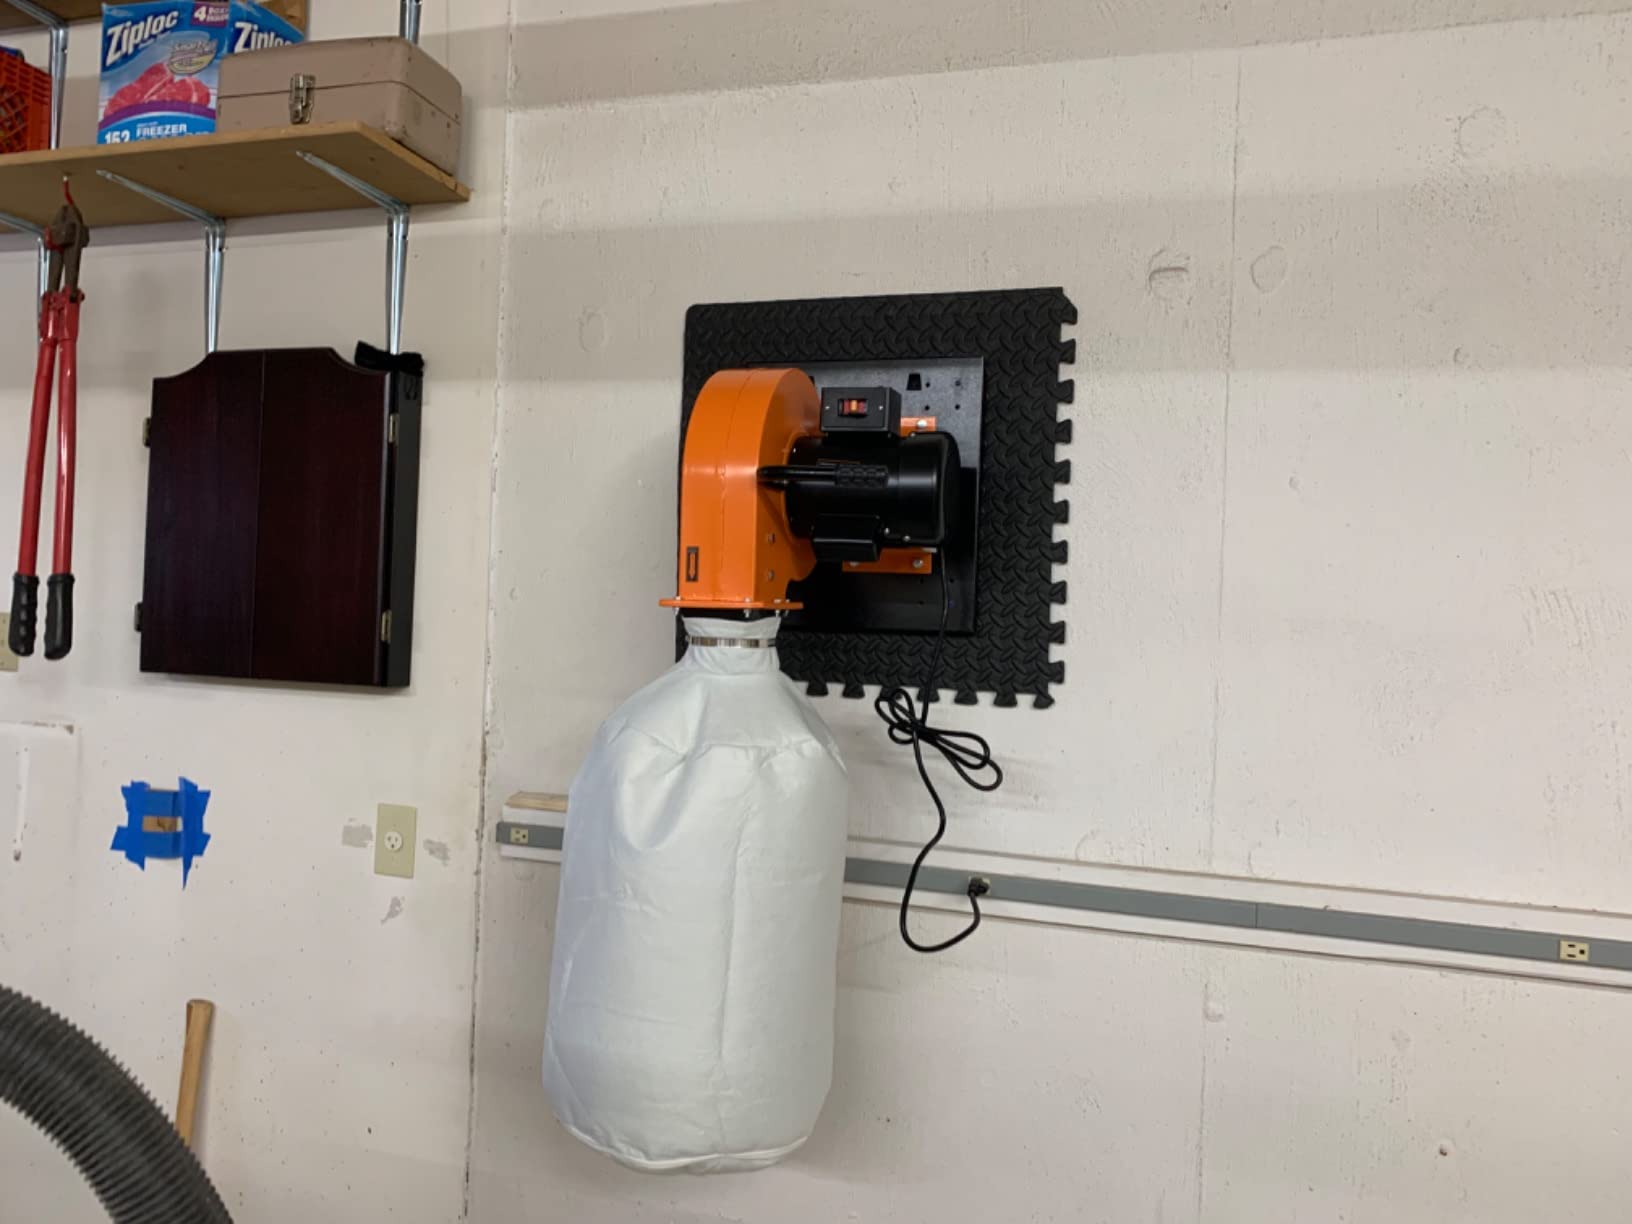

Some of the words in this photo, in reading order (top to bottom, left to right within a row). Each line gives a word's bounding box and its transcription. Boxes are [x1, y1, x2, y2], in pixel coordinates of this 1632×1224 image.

[194, 5, 207, 22] 4
[106, 11, 179, 67] Ziploc
[136, 123, 187, 138] FREEZER
